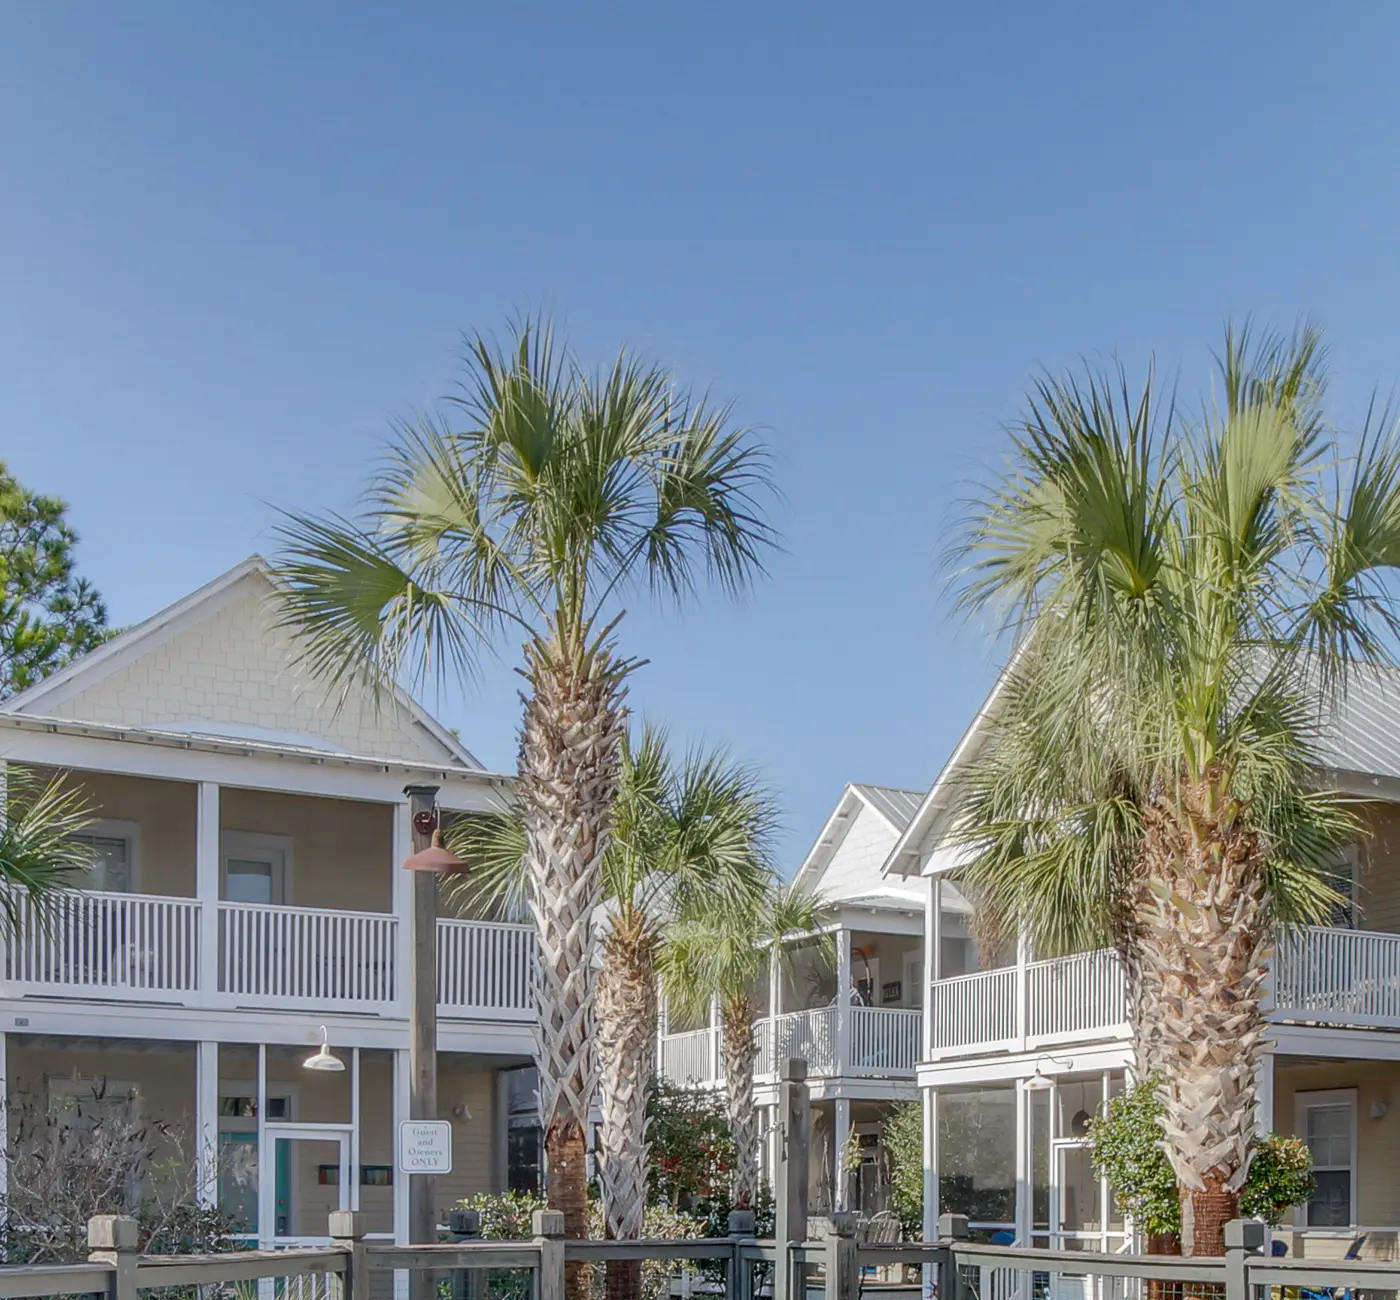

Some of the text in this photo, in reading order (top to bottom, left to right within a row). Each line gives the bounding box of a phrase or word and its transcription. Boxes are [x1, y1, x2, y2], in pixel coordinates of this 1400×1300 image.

[412, 1128, 438, 1136] Guest
[417, 1138, 434, 1146] and
[408, 1147, 443, 1156] Owners
[411, 1158, 439, 1166] ONLY
